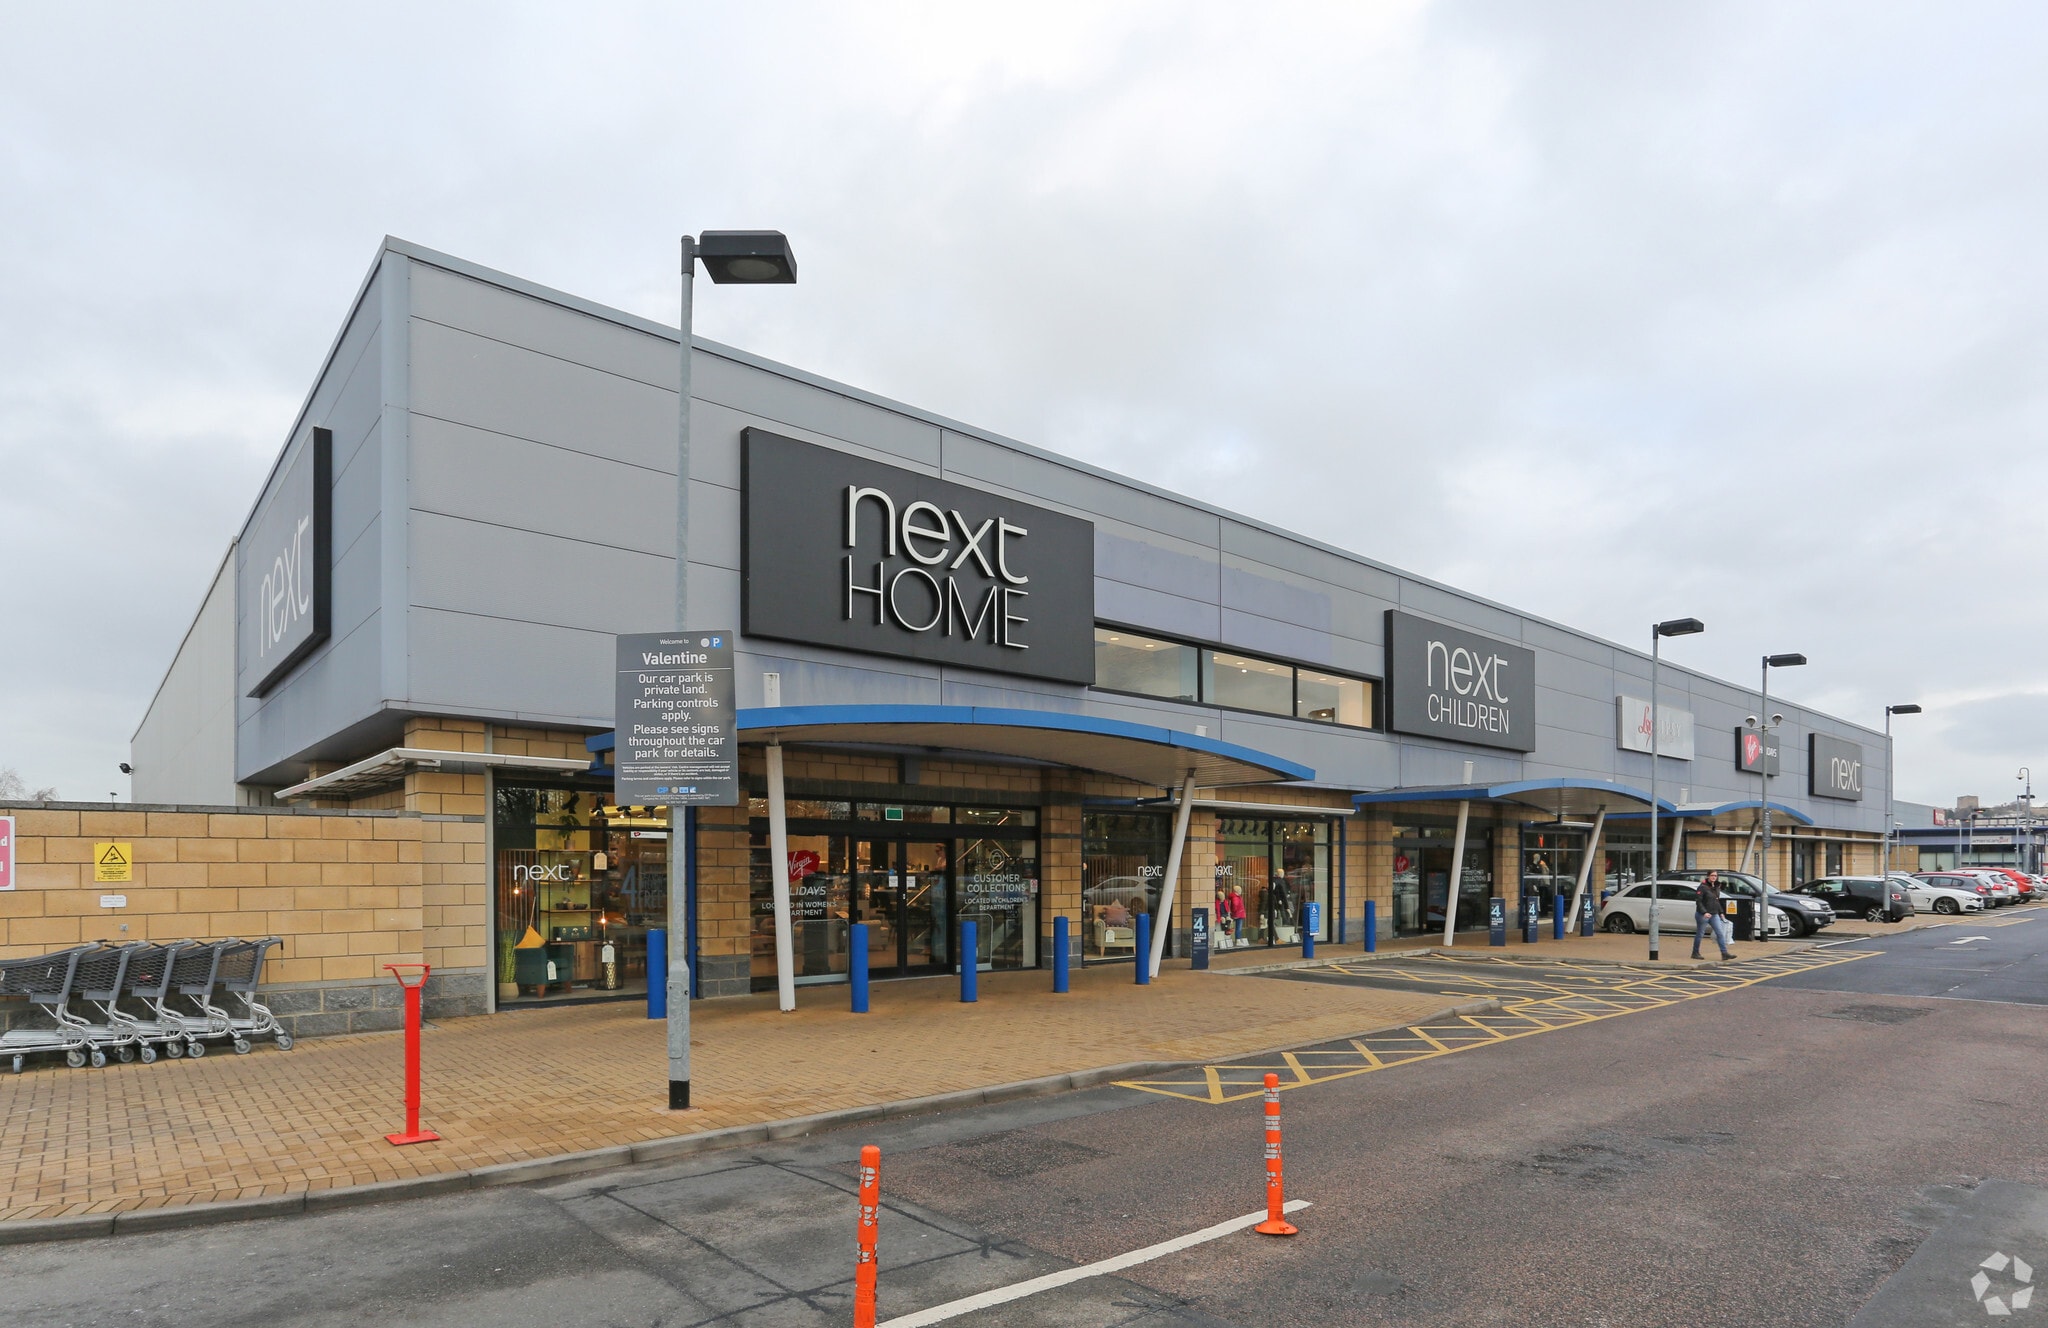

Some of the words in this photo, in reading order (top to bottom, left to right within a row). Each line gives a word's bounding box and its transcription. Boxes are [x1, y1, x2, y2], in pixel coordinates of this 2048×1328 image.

[849, 484, 1029, 584] next
[261, 515, 309, 657] next
[848, 555, 1029, 649] HOME
[642, 651, 708, 665] Valentine
[638, 674, 658, 683] Our
[659, 675, 676, 683] car
[678, 673, 702, 685] park
[704, 672, 714, 682] is
[1427, 640, 1509, 704] next
[644, 685, 680, 697] private
[682, 684, 708, 694] land.
[633, 699, 674, 710] Parking
[676, 698, 719, 708] controls
[661, 710, 691, 722] apply.
[1427, 694, 1510, 734] CHILDREN
[633, 724, 668, 734] Please
[670, 726, 690, 734] see
[691, 724, 720, 735] signs
[628, 736, 686, 748] throughout
[688, 736, 705, 745] the
[707, 737, 725, 745] car
[635, 748, 659, 760] park
[664, 748, 679, 757] for
[681, 747, 720, 757] details.
[1831, 757, 1861, 793] next
[787, 852, 812, 876] Virgin
[514, 864, 570, 881] next
[1137, 865, 1163, 877] next
[973, 874, 1020, 882] CUSTOMER
[788, 886, 827, 896] LIDAYS
[967, 883, 1026, 893] COLLECTIONS
[1491, 905, 1501, 917] 4
[1529, 903, 1536, 915] 4
[1584, 900, 1591, 911] 4
[1193, 917, 1204, 932] 4
